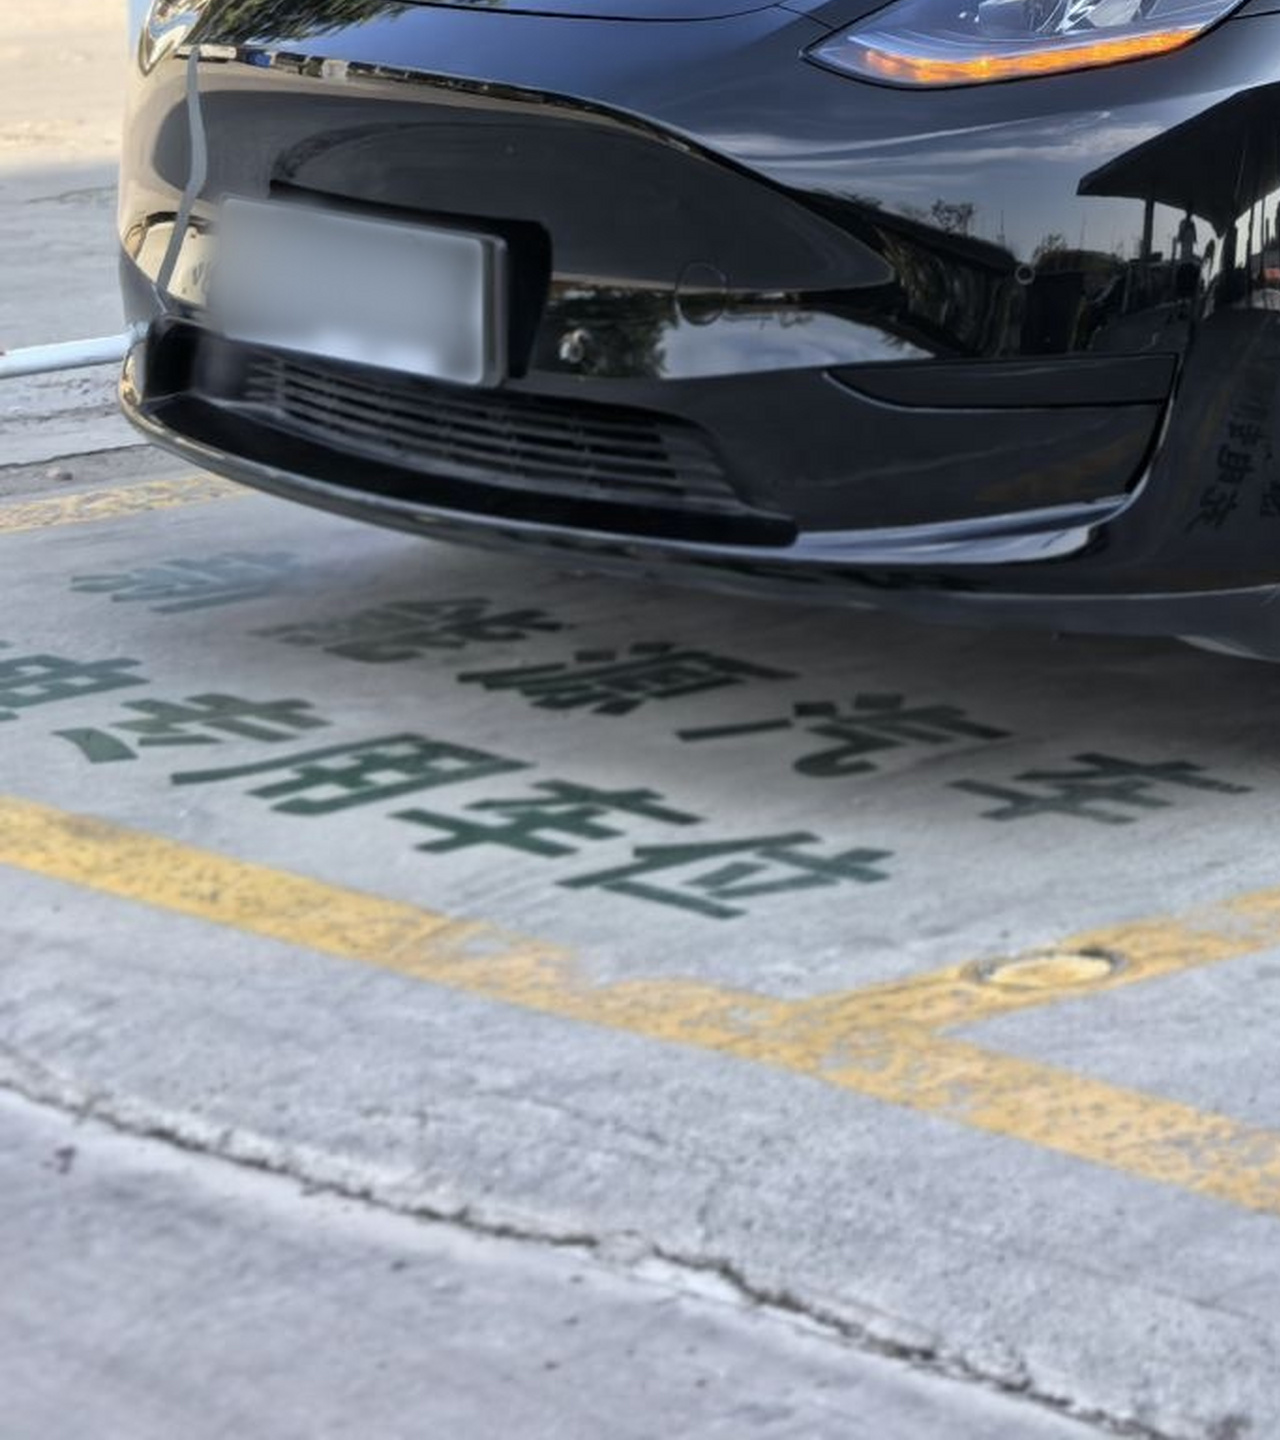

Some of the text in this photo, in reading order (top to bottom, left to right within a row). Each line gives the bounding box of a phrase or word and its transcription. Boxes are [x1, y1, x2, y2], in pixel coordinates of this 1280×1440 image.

[0, 640, 895, 920] 电专用车位
